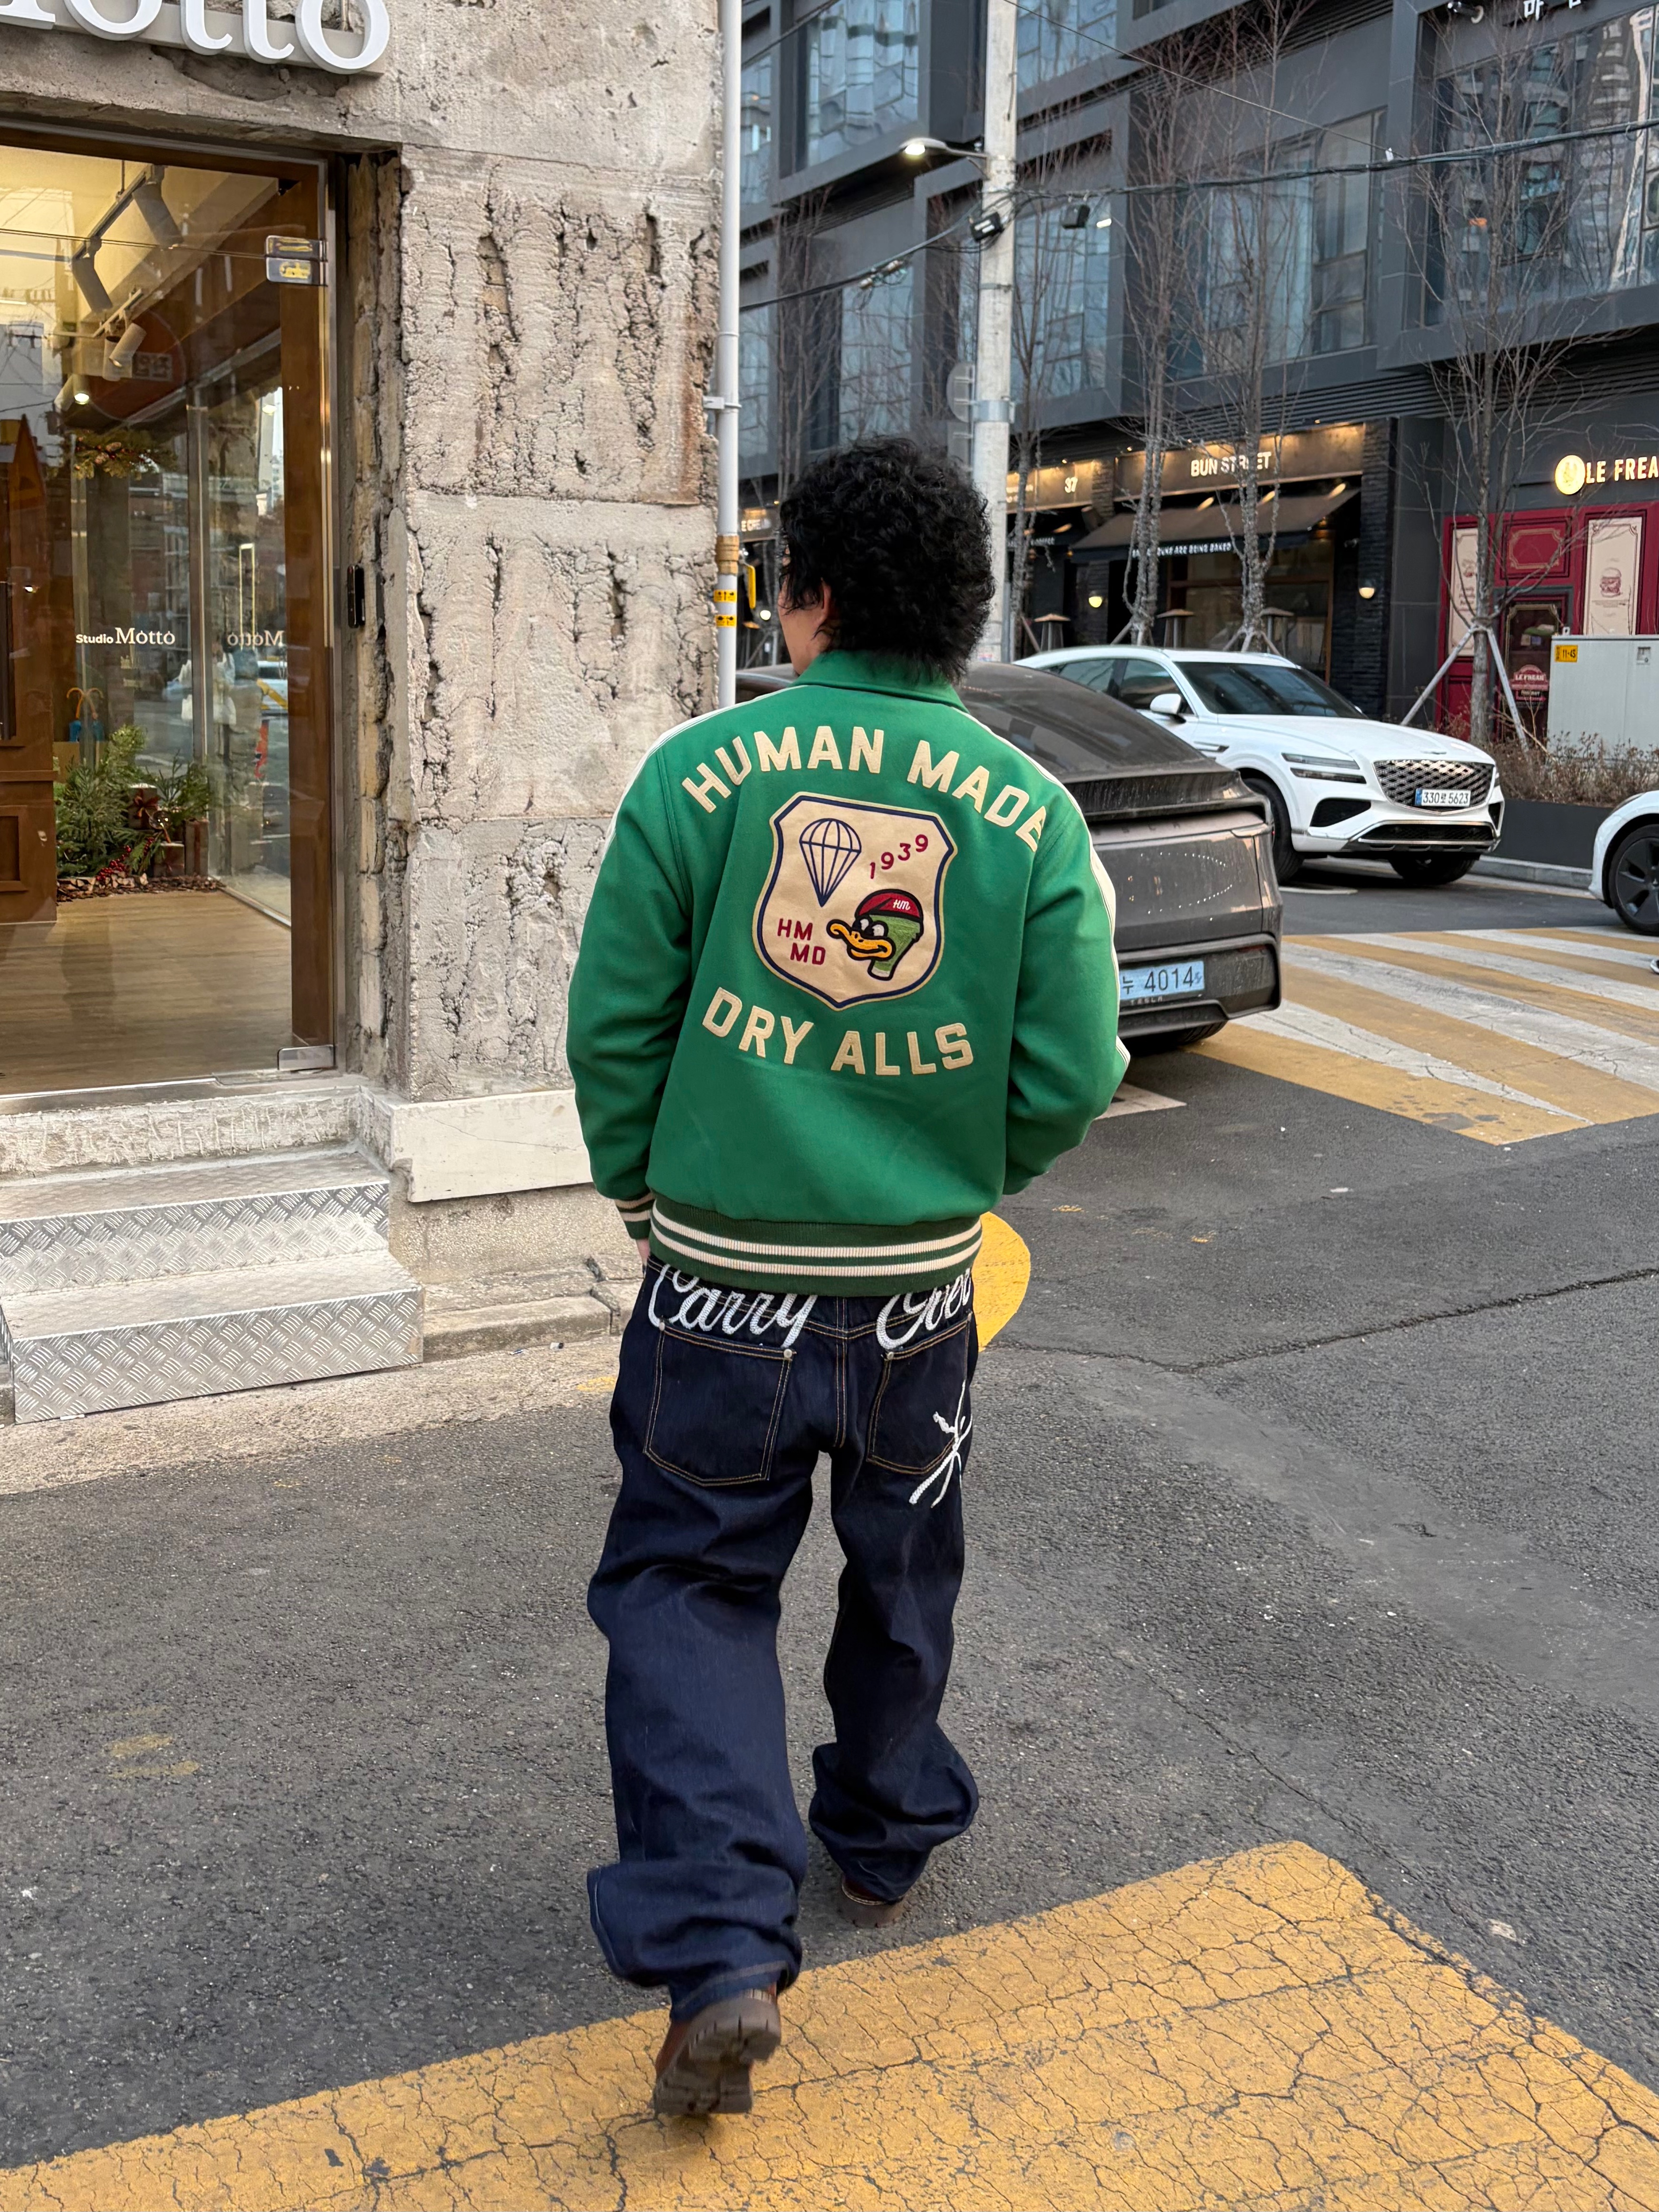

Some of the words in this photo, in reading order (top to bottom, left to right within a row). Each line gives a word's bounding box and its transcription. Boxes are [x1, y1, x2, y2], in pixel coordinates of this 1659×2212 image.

[1191, 458, 1217, 477] BUN
[1221, 452, 1272, 473] STRET
[1586, 461, 1606, 483] LE
[76, 634, 114, 644] Studio
[115, 627, 175, 645] Motto
[682, 725, 884, 813] HUMAN
[907, 740, 1046, 852] MADE
[1448, 792, 1469, 804] 5623
[870, 834, 929, 879] 1939
[777, 918, 813, 941] HM
[790, 943, 826, 965] MD
[1144, 966, 1194, 992] 4014
[702, 986, 814, 1064] DRY
[830, 1023, 974, 1076] ALLS
[648, 1264, 818, 1349] Carry
